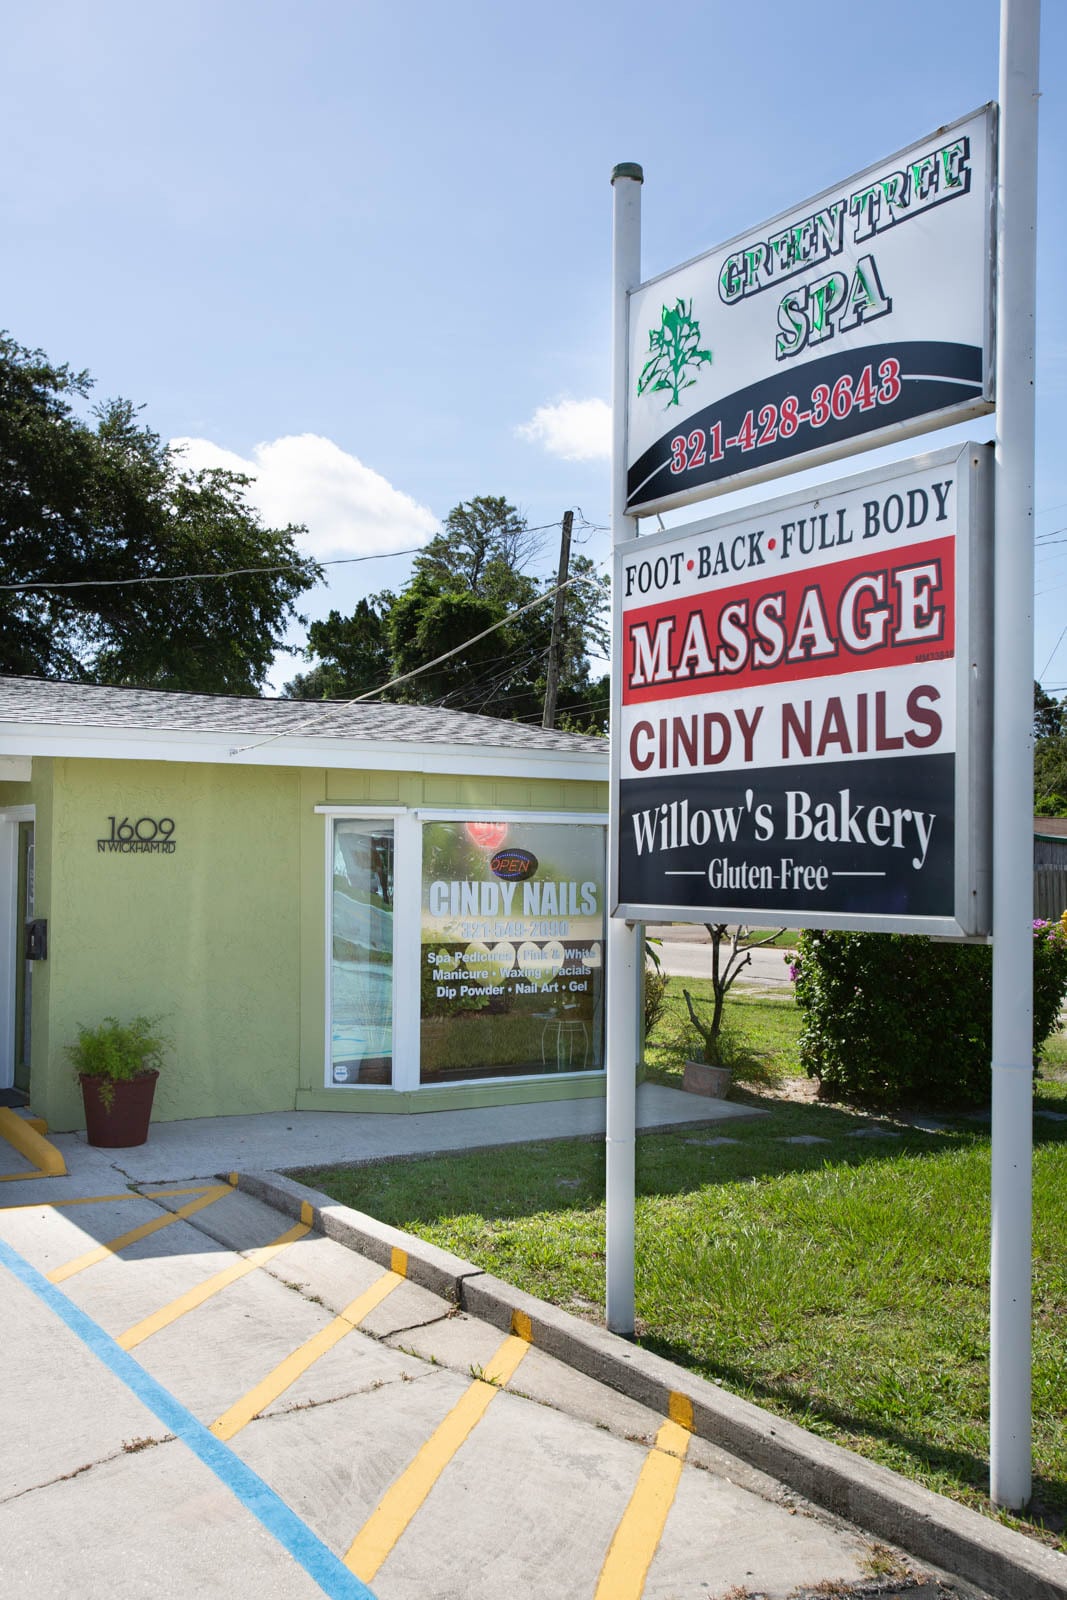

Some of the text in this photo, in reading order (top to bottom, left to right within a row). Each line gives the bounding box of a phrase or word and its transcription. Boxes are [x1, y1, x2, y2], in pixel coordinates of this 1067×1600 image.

[775, 254, 892, 360] SPA
[670, 357, 901, 474] 321-428-3643
[625, 480, 953, 596] FOOT BACK FULL BODY
[628, 557, 945, 689] MASSAGE
[629, 684, 942, 771] CINDY NAILS
[108, 817, 175, 841] 1609
[632, 788, 936, 870] Willow's Bakery
[97, 840, 176, 854] N WICKHAM RD
[490, 859, 531, 873] OPEN
[708, 857, 829, 890] Gluten-Free
[429, 881, 597, 917] CINDY NAILS
[427, 951, 450, 964] Spa
[564, 948, 597, 960] White
[433, 966, 591, 981] Manicure Waxing Facials
[437, 981, 587, 998] Dip Powder Nail Art Gel
